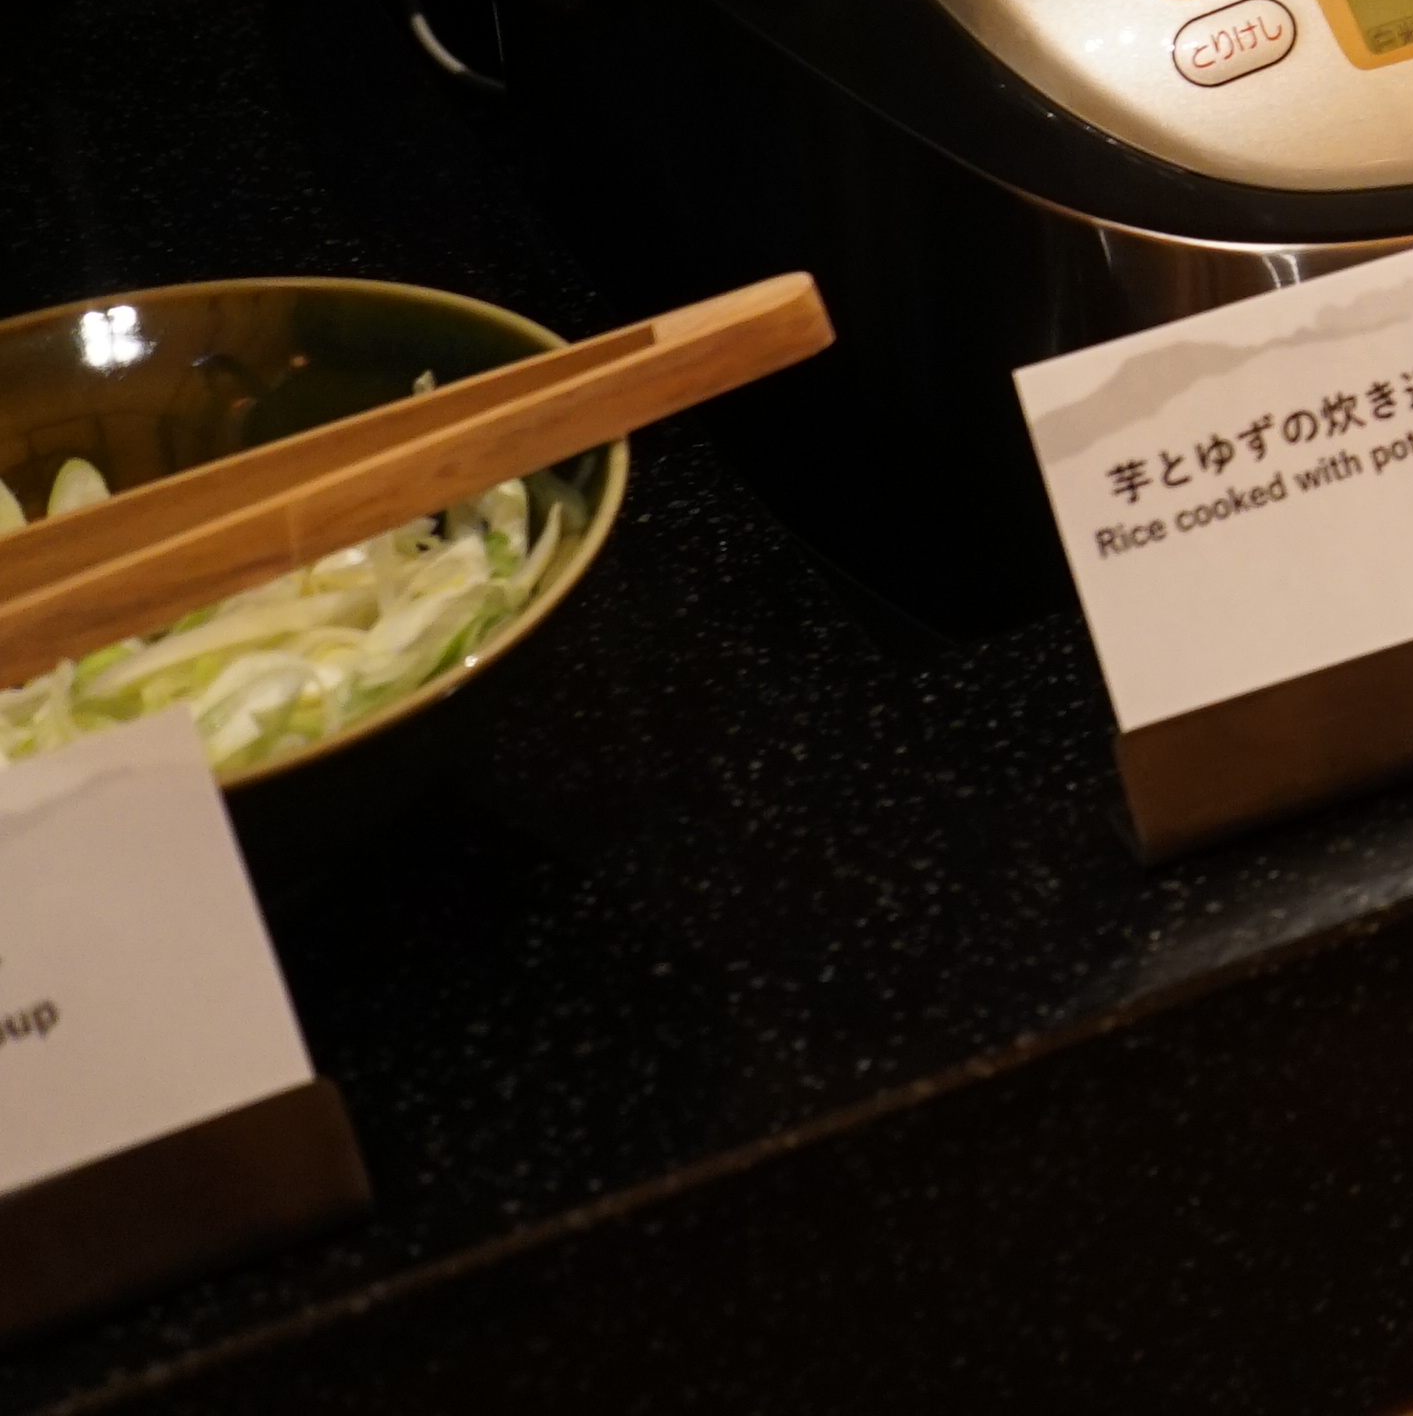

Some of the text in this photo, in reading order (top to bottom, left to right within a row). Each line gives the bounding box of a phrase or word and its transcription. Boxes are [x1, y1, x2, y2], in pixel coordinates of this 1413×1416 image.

[1192, 16, 1283, 69] とりけし
[1095, 517, 1168, 560] Rice
[1175, 471, 1289, 534] cooked
[1293, 449, 1364, 495] with
